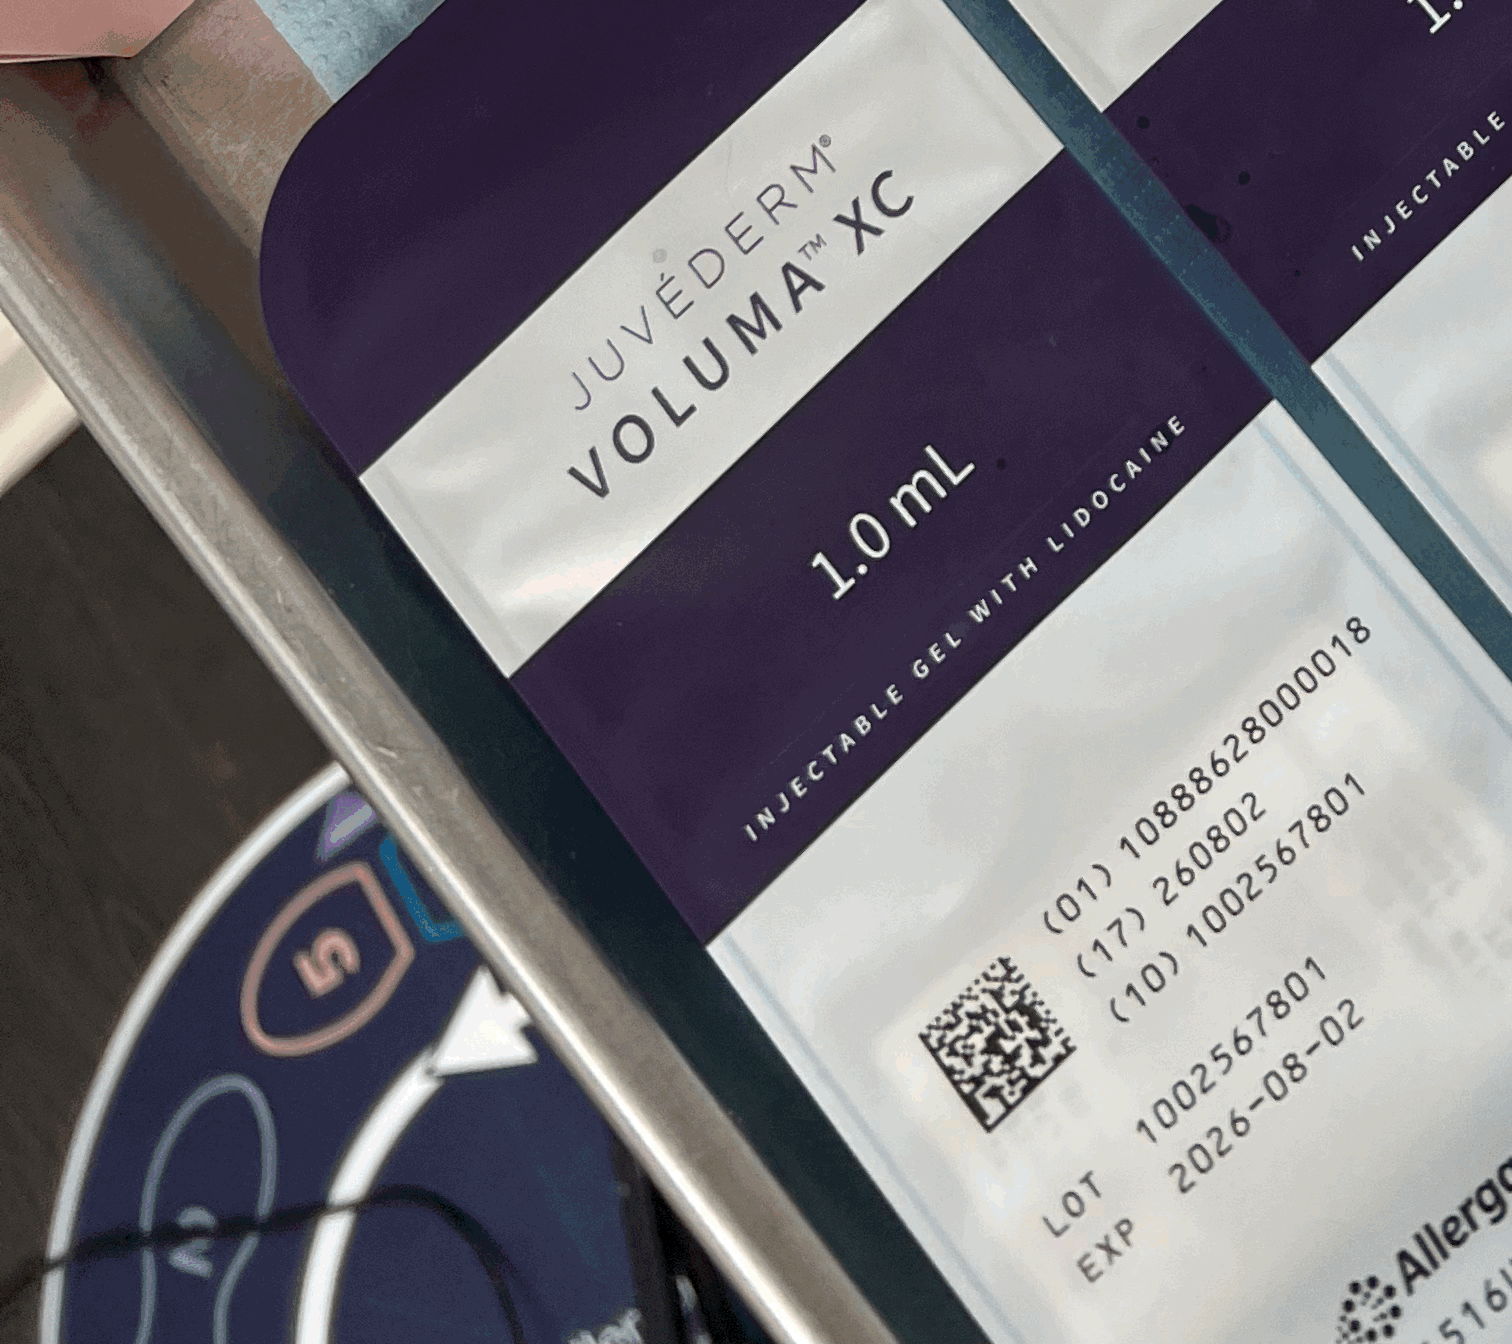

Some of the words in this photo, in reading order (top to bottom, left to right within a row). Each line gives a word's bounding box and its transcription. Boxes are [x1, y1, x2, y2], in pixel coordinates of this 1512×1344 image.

[833, 169, 914, 254] XC
[1351, 112, 1506, 263] INJECTABLE
[744, 686, 904, 842] INJECTABLE
[912, 631, 961, 680] GEL
[969, 557, 1038, 626] WITH
[1047, 415, 1186, 554] LIDOCAINE
[811, 512, 891, 600] 1.0
[889, 444, 975, 526] mL
[1042, 863, 1112, 935] (01)
[1120, 616, 1372, 860] 10888628000018
[1076, 906, 1146, 978] (17)
[1154, 791, 1267, 905] 260802
[1110, 951, 1180, 1023] (10)
[1186, 771, 1367, 948] 1002567801
[1042, 1171, 1103, 1238] LOT
[1137, 956, 1328, 1143] 1002567801
[1076, 1217, 1136, 1283] EXP
[1168, 998, 1366, 1192] 2026-08-02
